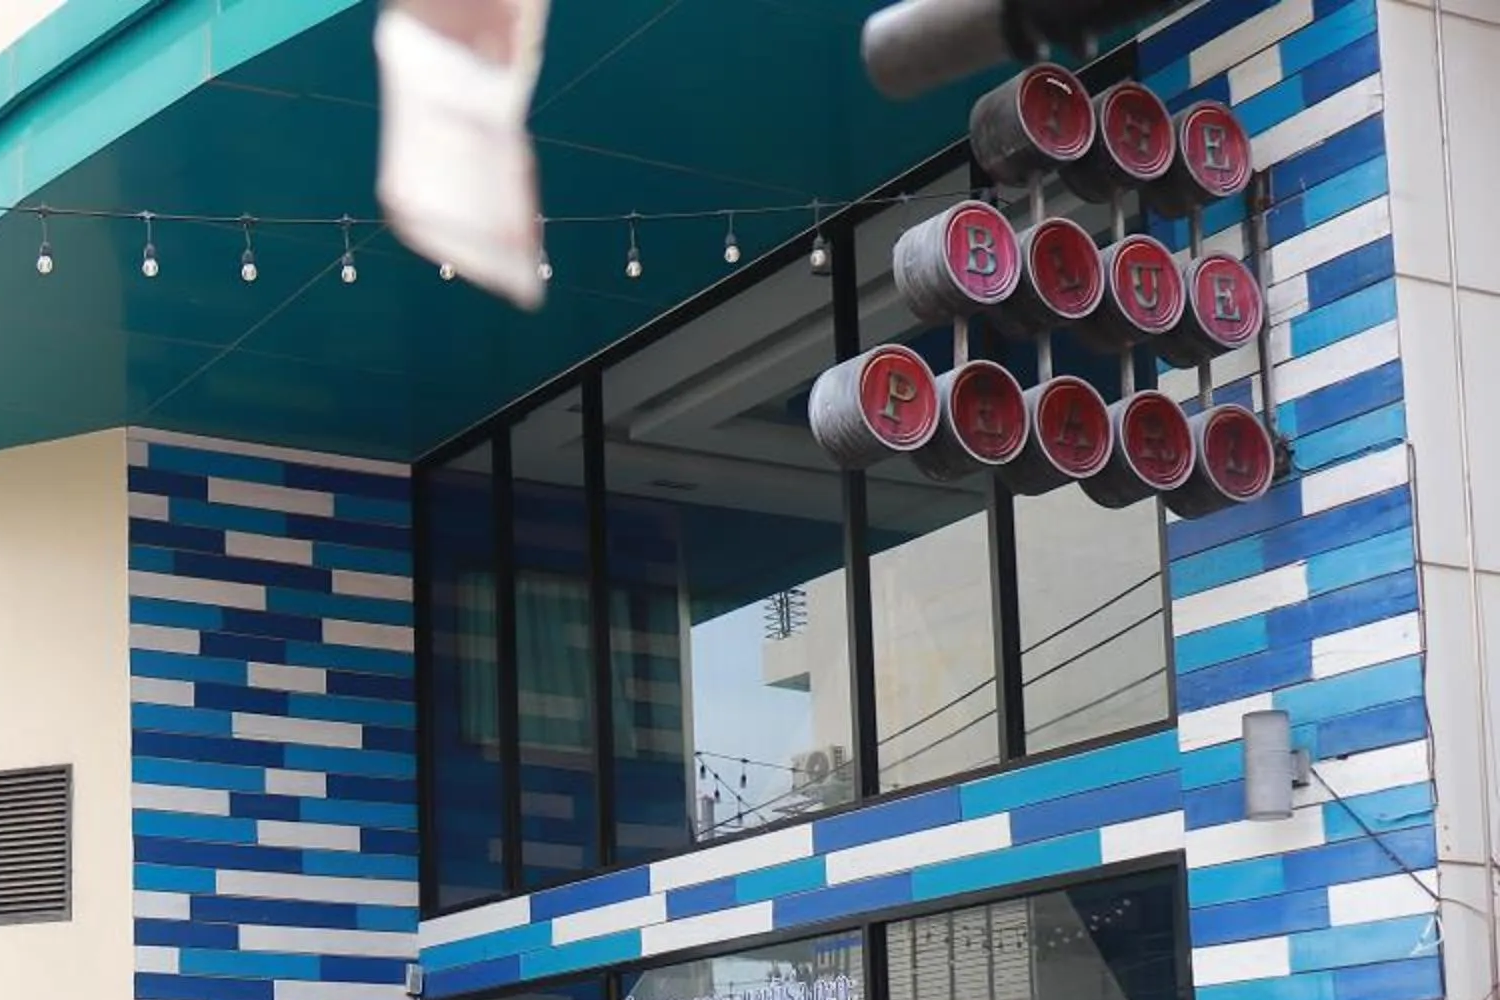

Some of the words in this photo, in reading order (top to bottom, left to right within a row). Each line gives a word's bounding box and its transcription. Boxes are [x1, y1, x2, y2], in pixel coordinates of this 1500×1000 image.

[1040, 92, 1233, 171] THE
[965, 223, 1243, 322] BLUE
[883, 370, 1252, 477] PEARL
